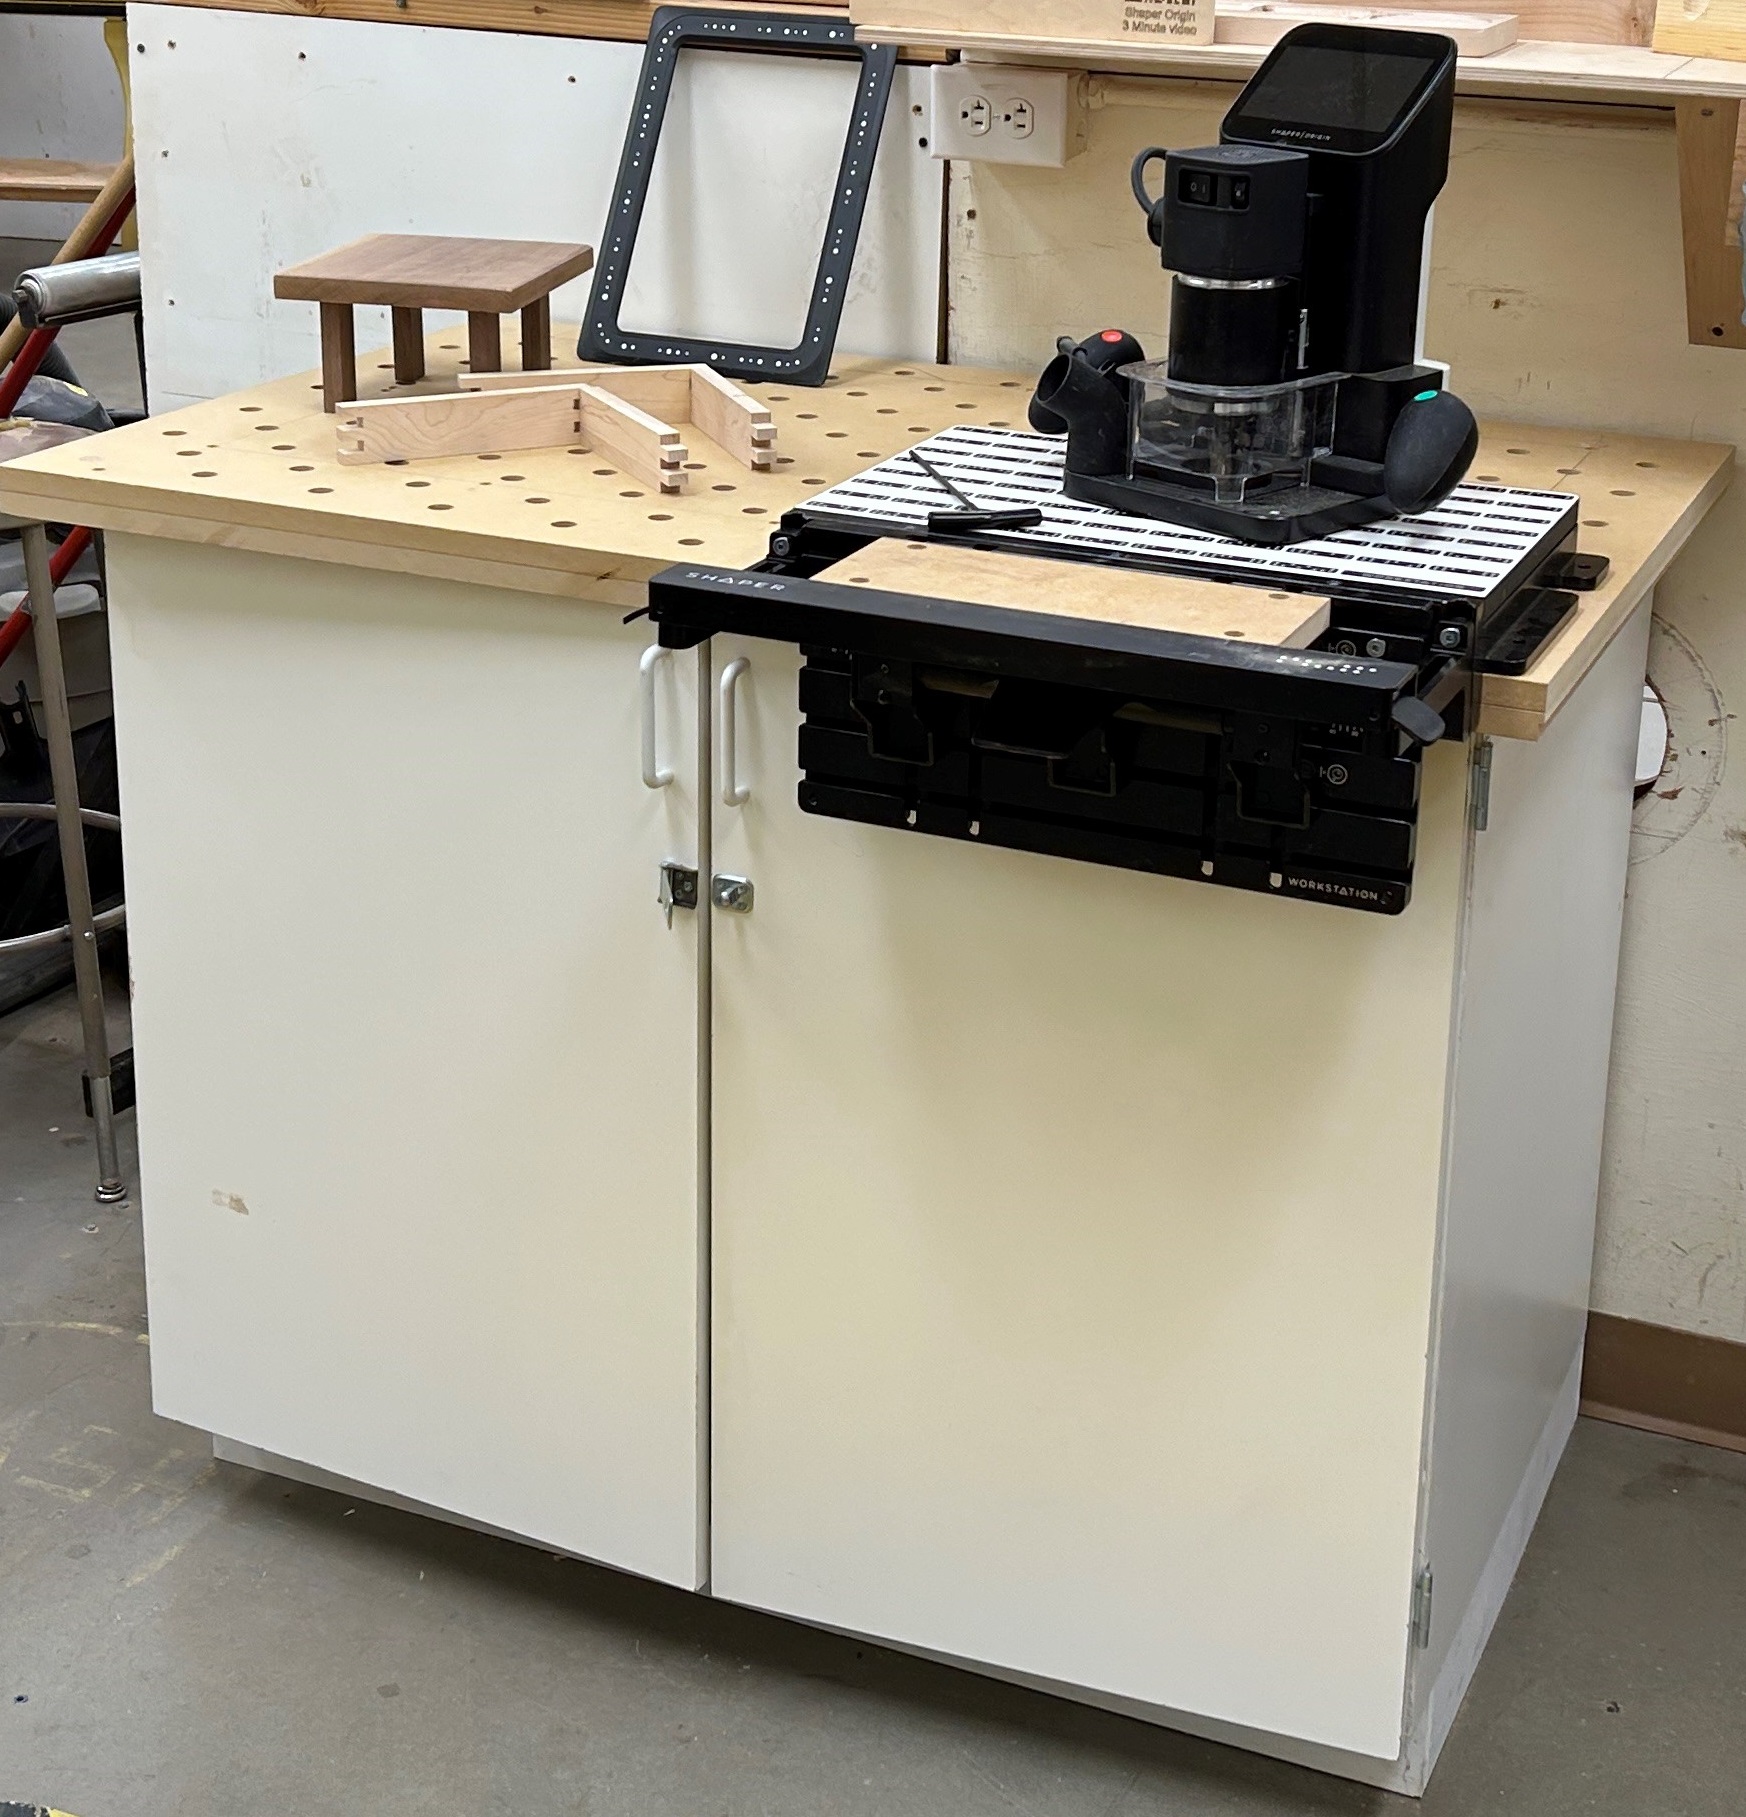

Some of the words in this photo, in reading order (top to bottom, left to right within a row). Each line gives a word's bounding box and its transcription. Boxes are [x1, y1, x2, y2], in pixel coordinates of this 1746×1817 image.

[1125, 7, 1162, 20] Shaper
[1165, 9, 1195, 23] Origin
[1122, 19, 1129, 31] 3
[1132, 20, 1166, 33] Minute
[685, 571, 786, 591] SHAPER
[1288, 877, 1378, 900] WORKSTATION
